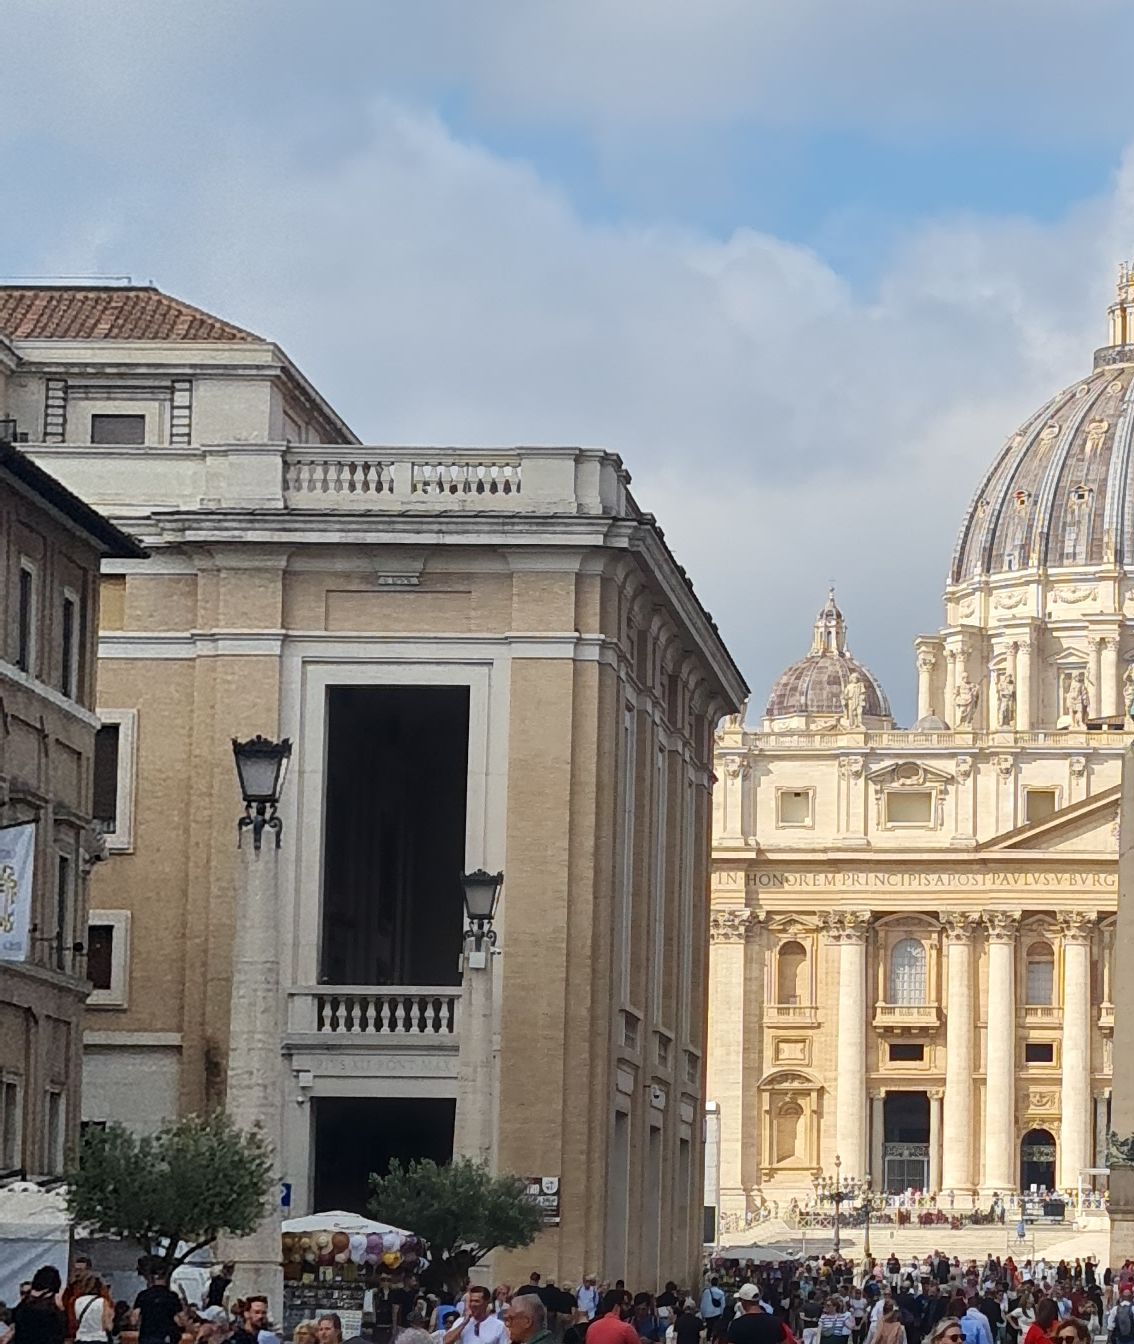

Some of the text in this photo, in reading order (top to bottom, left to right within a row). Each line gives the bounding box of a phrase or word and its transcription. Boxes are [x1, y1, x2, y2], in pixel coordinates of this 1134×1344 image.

[717, 872, 738, 886] IN
[746, 873, 837, 887] HONOREM
[842, 872, 932, 887] PRINCIPIS
[991, 872, 1051, 886] PAVLVS
[1069, 872, 1116, 887] BVRG
